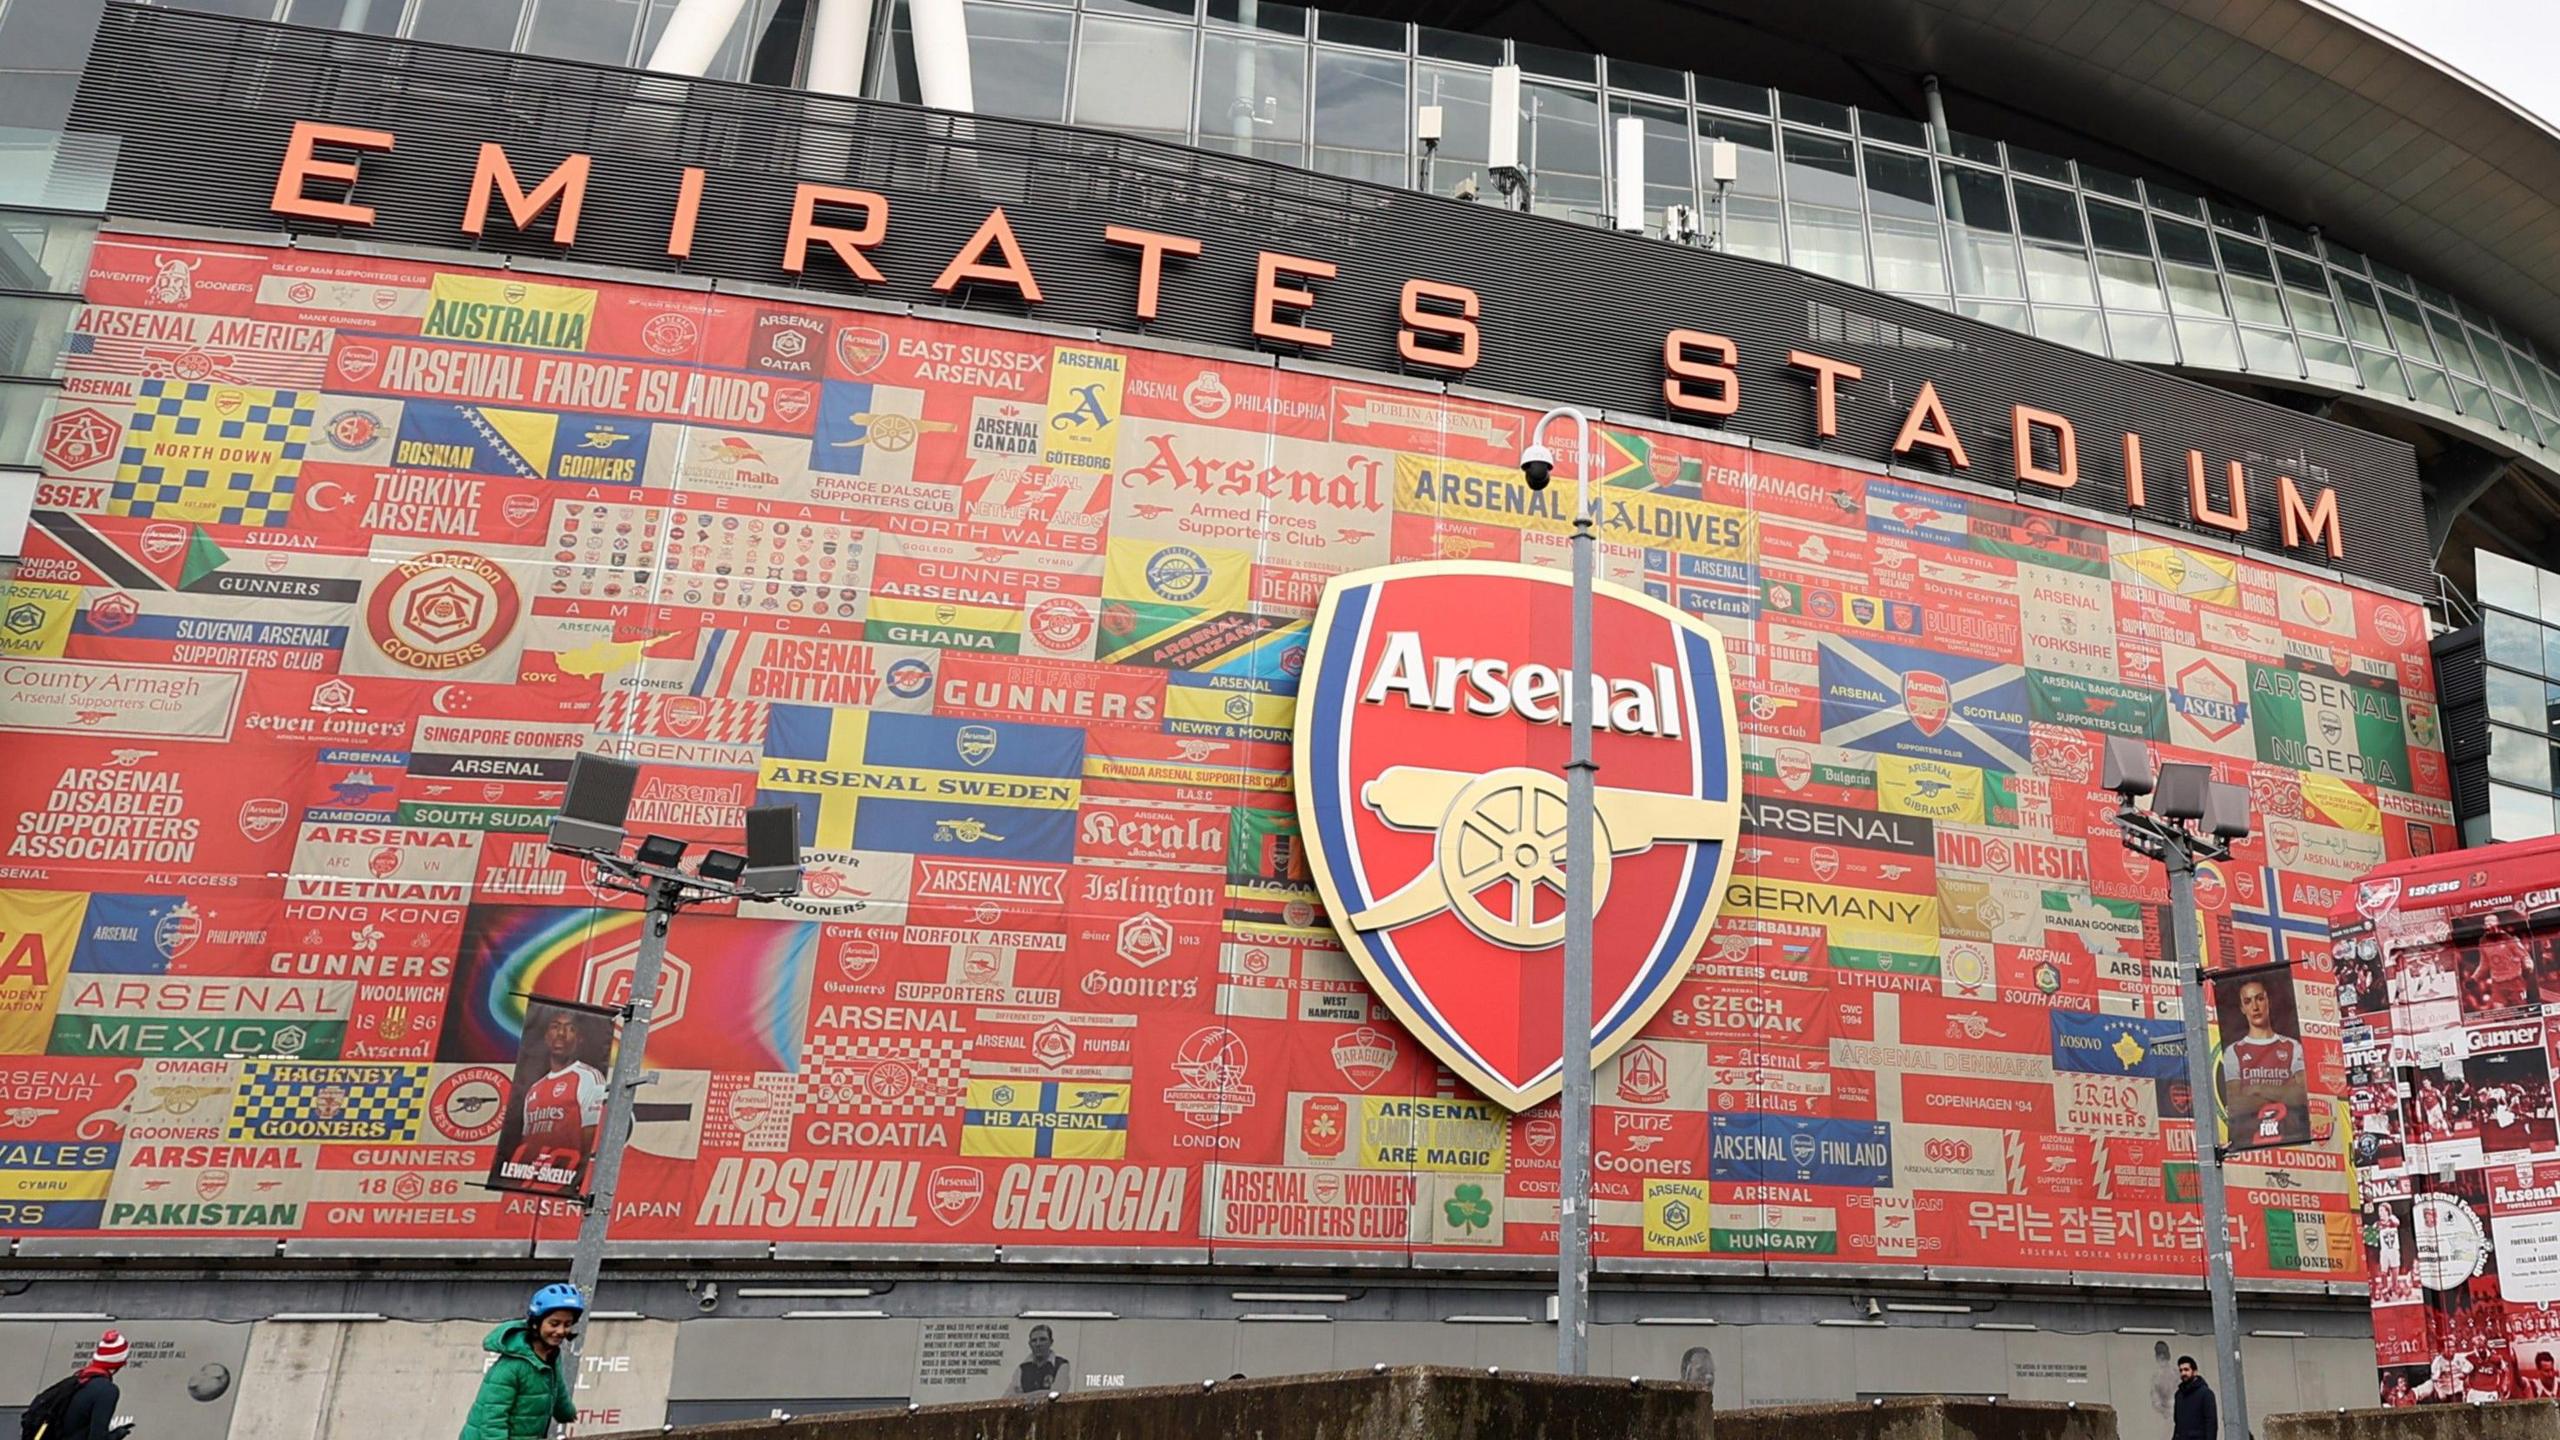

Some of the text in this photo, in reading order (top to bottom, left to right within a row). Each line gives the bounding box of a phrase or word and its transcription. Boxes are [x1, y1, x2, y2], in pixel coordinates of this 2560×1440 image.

[90, 270, 253, 293] DAVENTRY GOONERS
[76, 307, 325, 353] ARSENAL AMERICA
[426, 299, 585, 349] AUSTRALIA
[760, 315, 825, 334] ARSENAL
[270, 118, 2345, 558] EMIRATES STADIUM
[761, 356, 811, 372] QATAR
[898, 338, 1045, 373] EAST SUSSEX
[1058, 351, 1120, 372] ARSENAL
[380, 346, 768, 423] ARSENAL FAROE ISLANDS
[915, 362, 1025, 391] ARSENAL
[1127, 379, 1326, 421] ARSENAL PHILADELPHIA
[976, 416, 1039, 438] ARSENAL
[154, 442, 271, 464] NORTH DOWN
[973, 435, 1037, 455] CANADA
[1121, 434, 1384, 513] Arsenal
[1706, 466, 1824, 503] FERMANAGH
[810, 490, 954, 513] SUPPORTERS CLUB
[360, 506, 480, 537] ARSENAL
[1190, 503, 1317, 530] Armed Forces
[245, 531, 317, 548] SUDAN
[889, 516, 1098, 551] NORTH WALES
[1178, 519, 1326, 548] Supporters Club
[918, 563, 1061, 589] GUNNERS
[1693, 559, 1747, 581] ARSENAL
[219, 576, 320, 595] GUNNERS
[880, 581, 1016, 605] ARSENAL
[1924, 583, 2016, 608] SOUTH CENTRAL
[2033, 586, 2100, 612] ARSENAL
[176, 619, 330, 647] SLOVENIA ARSENAL
[887, 627, 995, 649] GHANA
[1153, 615, 1245, 664] ARSENAL
[761, 638, 876, 675] ARSENAL
[2027, 633, 2112, 660] YORKSHIRE
[172, 646, 323, 670] SUPPORTERS CLUB
[4, 666, 200, 698] County Armagh
[750, 668, 881, 705] BRITTANY
[1209, 675, 1272, 692] ARSENAL
[943, 680, 1157, 720] GUNNERS
[1830, 685, 2023, 724] ARSENAL SCOTLAND
[2254, 669, 2399, 723] ARSENAL
[2182, 697, 2236, 723] ASCFR
[424, 726, 584, 747] SINGAPORE GOONERS
[327, 751, 401, 764] ARSENAL
[597, 740, 754, 765] ARGENTINA
[2272, 736, 2398, 785] NIGERIA
[451, 760, 544, 776] ARSENAL
[1907, 764, 1953, 778] ARSENAL
[56, 767, 184, 795] ARSENAL
[769, 767, 1071, 801] ARSENAL SWEDEN
[46, 790, 184, 817] DISABLED
[629, 800, 745, 827] MANCHESTER
[2383, 794, 2449, 819] ARSENAL
[16, 813, 200, 840] SUPPORTERS
[1740, 804, 1914, 846] ARSENAL
[7, 834, 195, 863] ASSOCIATION
[306, 828, 473, 848] ARSENAL
[510, 842, 550, 869] NEW
[482, 867, 567, 895] ZEALAND
[1082, 874, 1215, 908] Islington
[285, 904, 460, 923] HONG KONG
[1725, 885, 1921, 924] GERMANY
[904, 928, 1064, 950] NORFOLK ARSENAL
[270, 952, 451, 978] GUNNERS
[2017, 946, 2073, 966] ARSENAL
[1230, 975, 1358, 992] THE ARSENAL
[1770, 968, 1808, 983] CLUB
[1837, 972, 1933, 993] LITHUANIA
[73, 982, 338, 1013] ARSENAL
[361, 985, 445, 1003] WOOLWICH
[898, 985, 1058, 1005] SUPPORTERS CLUB
[1322, 996, 1347, 1007] WEST
[1692, 994, 1783, 1013] CZECH
[2005, 990, 2091, 1011] SOUTH AFRICA
[815, 1005, 967, 1033] ARSENAL
[1308, 1007, 1360, 1020] HAMPSTEAD
[1839, 1004, 1863, 1014] CWC
[1841, 1014, 1863, 1025] 1994
[2059, 1035, 2102, 1051] KOSOVO
[2470, 1027, 2538, 1050] Gunner
[155, 1060, 229, 1074] OMAGH
[272, 1066, 400, 1085] HACKNEY
[2243, 1068, 2290, 1079] Emirates
[983, 1111, 1107, 1129] HB ARSENAL
[1379, 1103, 1491, 1121] ARSENAL
[2069, 1111, 2147, 1128] GUNNERS
[129, 1127, 220, 1141] GOONERS
[259, 1119, 386, 1139] GOONERS
[806, 1121, 949, 1148] CROATIA
[2260, 1122, 2279, 1136] FOX
[1173, 1135, 1240, 1149] LONDON
[1713, 1135, 1888, 1167] ARSENAL FINLAND
[129, 1146, 302, 1168] ARSENAL
[352, 1149, 476, 1167] GUNNERS
[1378, 1148, 1490, 1165] ARE MAGIC
[1595, 1151, 1692, 1175] Gooners
[2277, 1153, 2336, 1168] LONDON
[501, 1161, 576, 1185] LEWIS-SKELLY
[695, 1158, 1188, 1232] ARSENAL GEORGIA
[1222, 1169, 1417, 1205] ARSENAL WOMEN
[1733, 1186, 1813, 1202] ARSENAL
[1846, 1194, 1943, 1211] PERUVIAN
[2247, 1191, 2320, 1208] GOONERS
[109, 1203, 297, 1226] PAKISTAN
[327, 1208, 476, 1225] ON WHEELS
[615, 1202, 682, 1221] JAPAN
[1225, 1204, 1408, 1238] SUPPORTERS CLUB
[2292, 1213, 2326, 1225] IRISH
[1969, 1202, 2054, 1241] 우리는
[2061, 1207, 2142, 1247] 잠들지
[2150, 1210, 2256, 1250] 않습다.
[1647, 1230, 1706, 1247] UKRAINE
[1729, 1233, 1818, 1250] HUNGARY
[1849, 1234, 1942, 1250] GUNNERS
[2285, 1256, 2343, 1269] GOONERS
[586, 1357, 630, 1371] THE
[1086, 1375, 1125, 1386] THE FANS
[576, 1409, 621, 1424] THE
